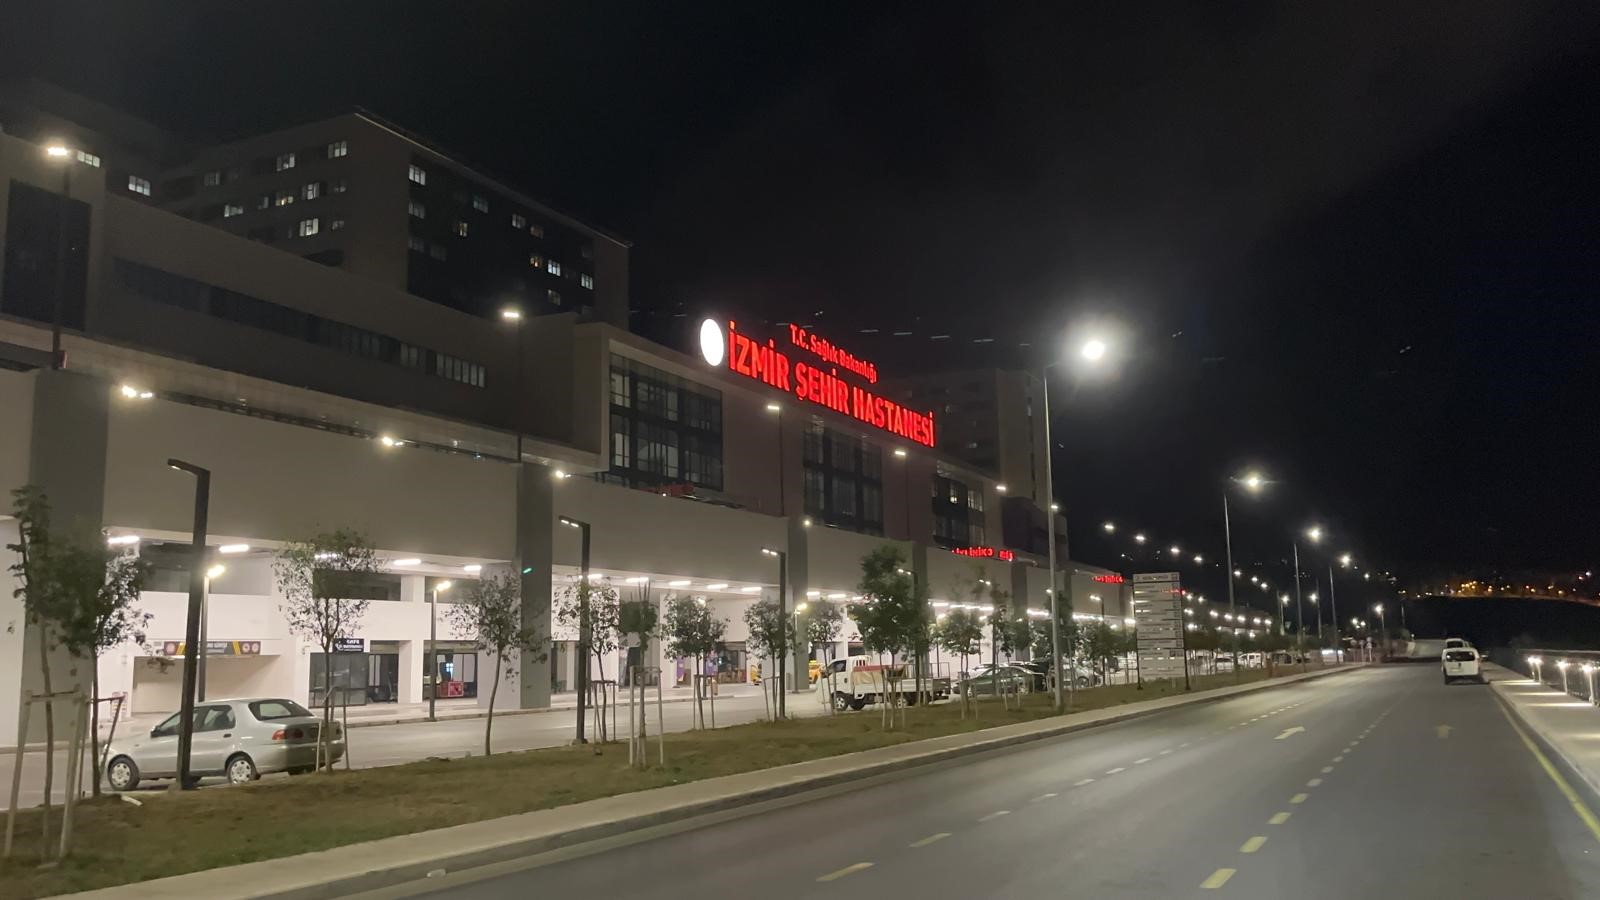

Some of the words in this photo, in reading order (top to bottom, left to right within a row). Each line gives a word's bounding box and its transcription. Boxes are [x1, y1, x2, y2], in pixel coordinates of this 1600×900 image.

[728, 319, 790, 392] İZMİR
[795, 362, 850, 415] ŞEHİR
[853, 386, 936, 448] HASTANESİ
[789, 323, 809, 350] T.C.
[810, 334, 838, 364] Sağlık
[839, 349, 877, 384] Bakanlığı
